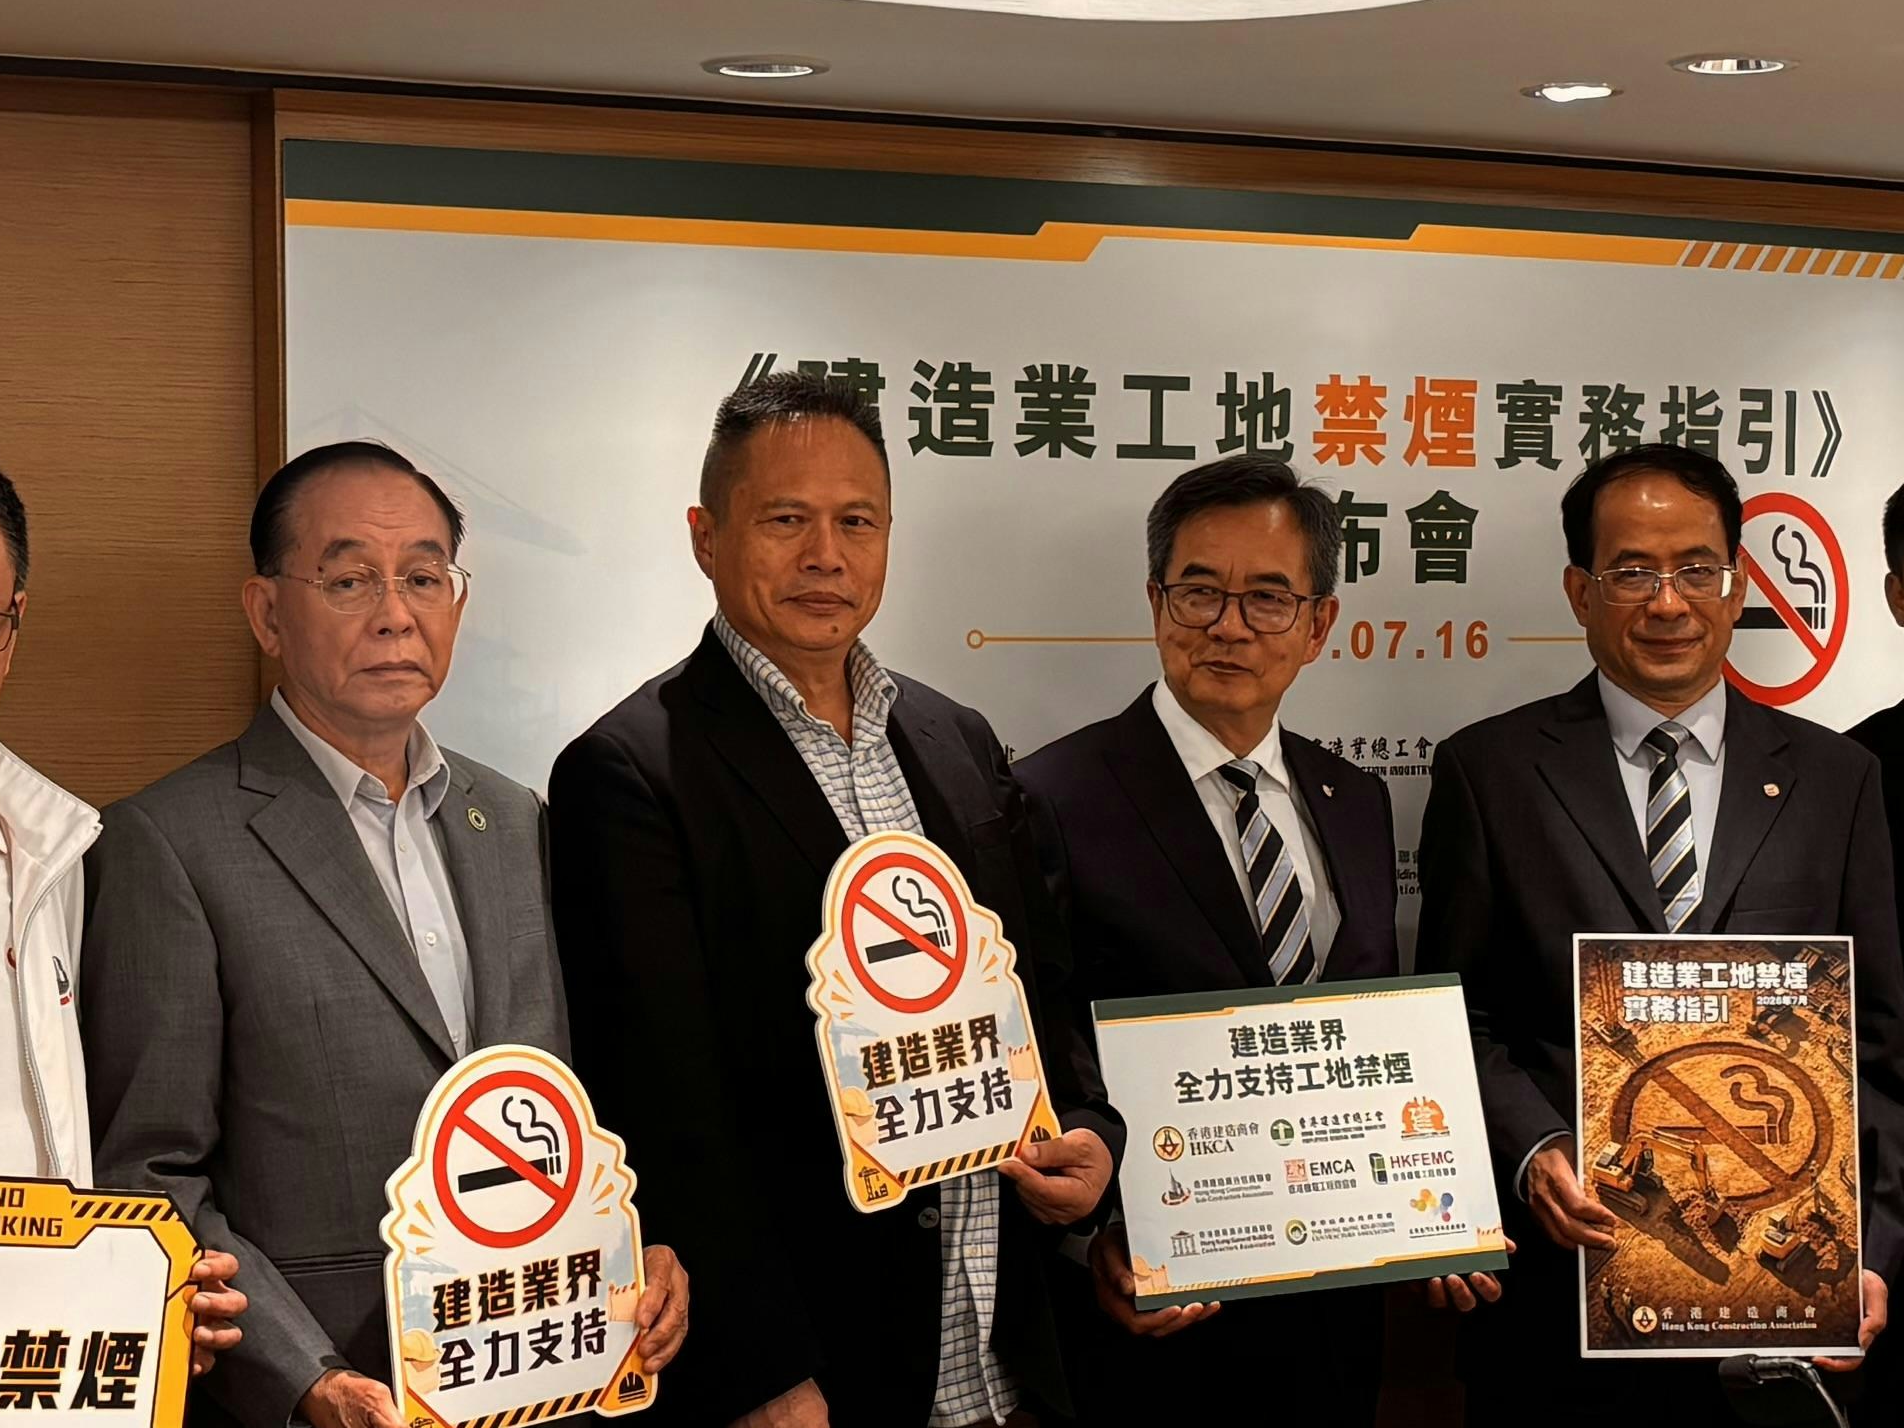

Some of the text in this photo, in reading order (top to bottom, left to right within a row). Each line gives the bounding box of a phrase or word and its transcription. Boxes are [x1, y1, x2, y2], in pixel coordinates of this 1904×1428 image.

[1312, 736, 1433, 761] 造業總工會
[1622, 961, 1808, 989] 建造業工地禁煙
[1623, 995, 1730, 1023] 實務指引
[860, 1013, 1000, 1091] 建造業界
[1228, 1018, 1347, 1059] 建造業界
[1174, 1052, 1414, 1104] 全力支持工地禁煙
[874, 1069, 1013, 1144] 全力支持
[1190, 1140, 1235, 1157] HKCA
[1390, 1151, 1455, 1169] HKFEMC
[1309, 1159, 1356, 1177] EMCA
[432, 1248, 602, 1333] 建造業界
[438, 1308, 607, 1392] 全力支持
